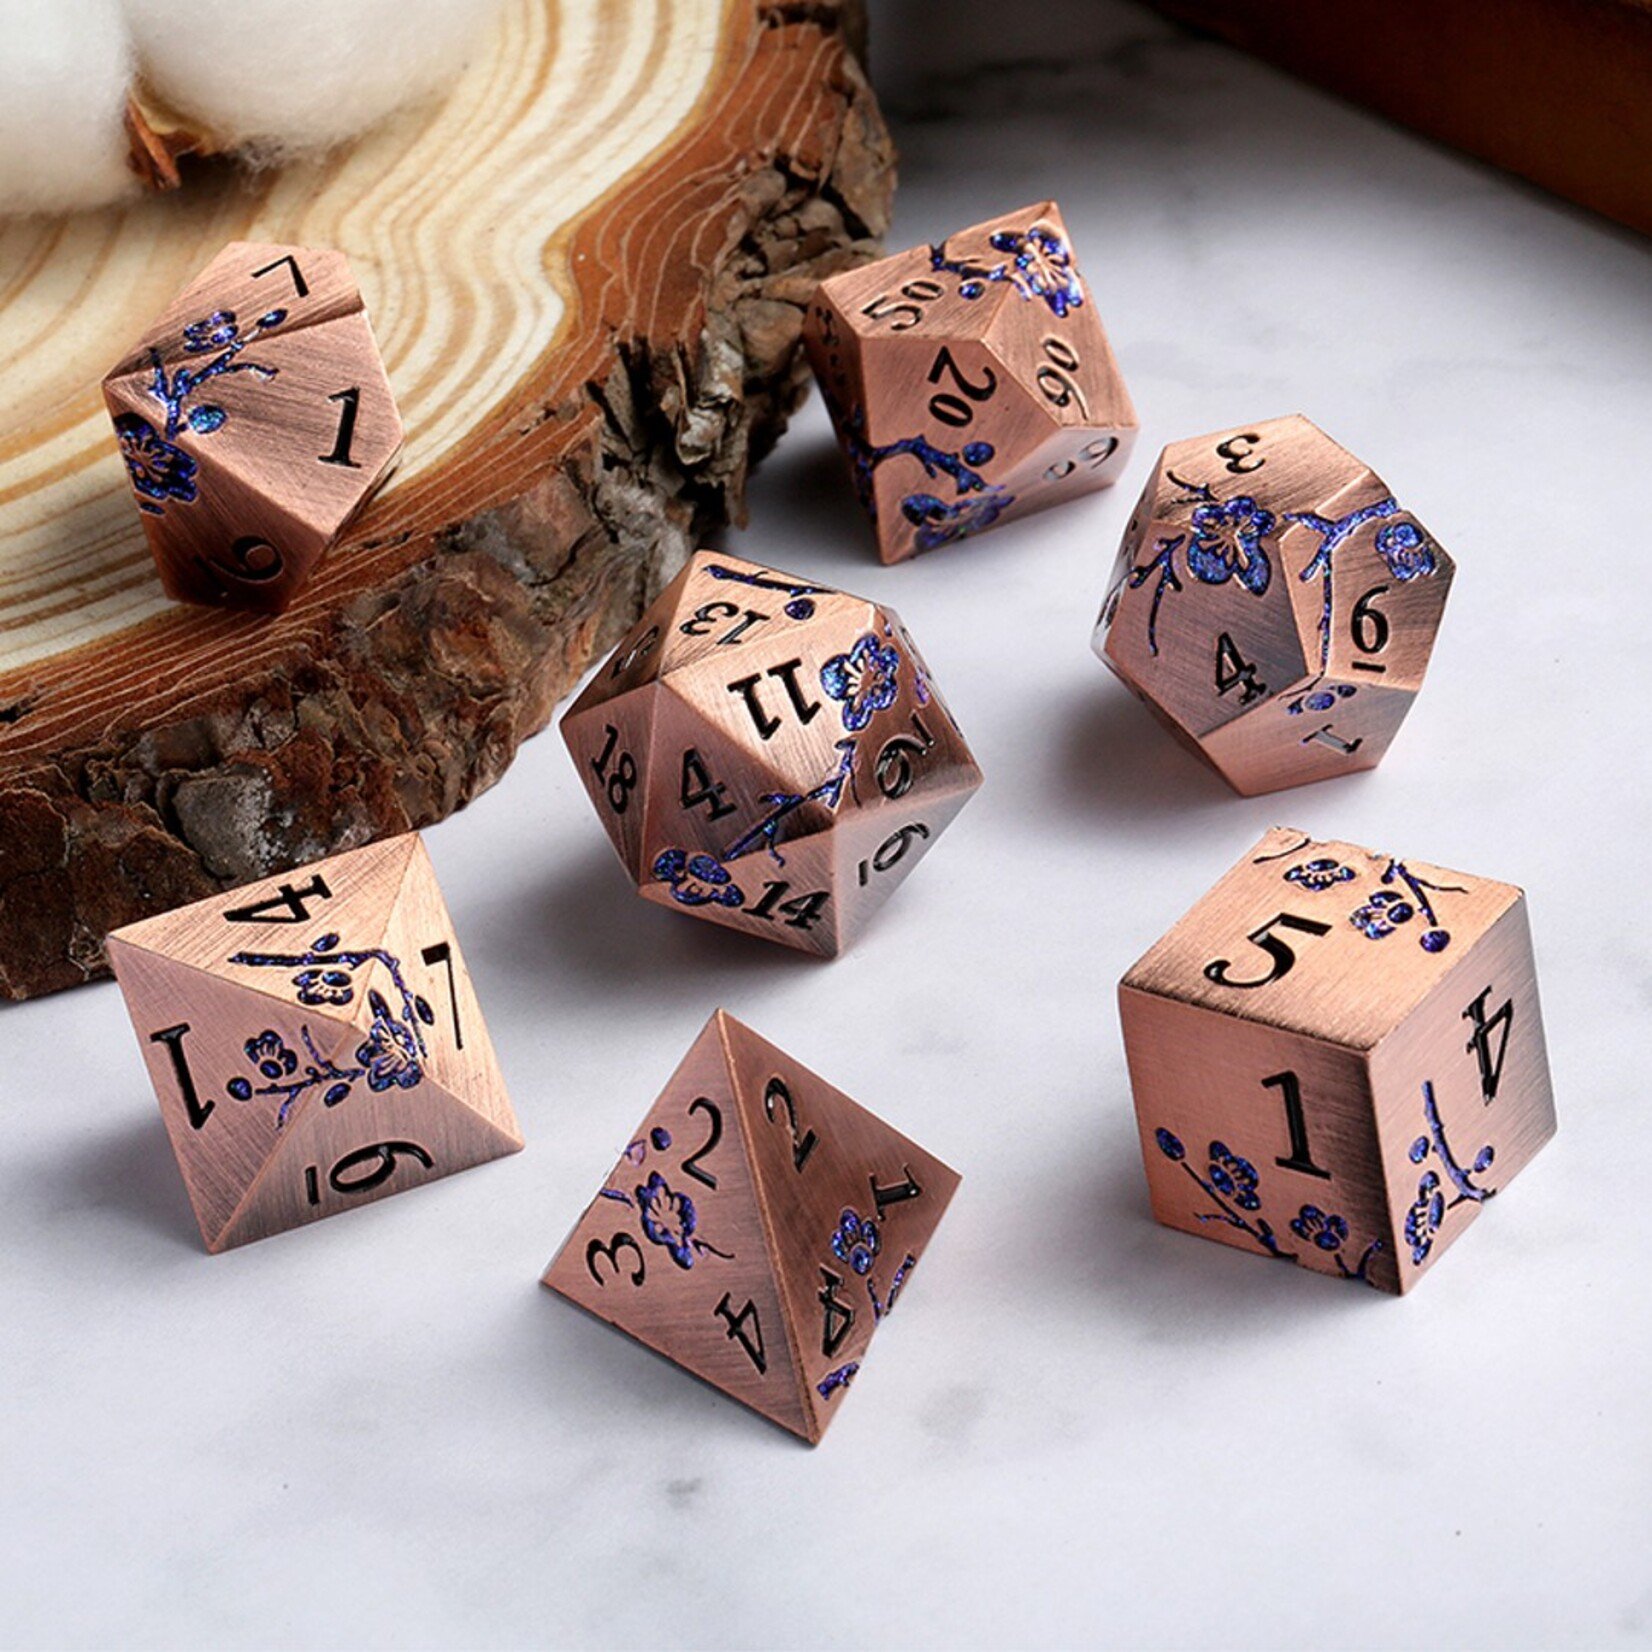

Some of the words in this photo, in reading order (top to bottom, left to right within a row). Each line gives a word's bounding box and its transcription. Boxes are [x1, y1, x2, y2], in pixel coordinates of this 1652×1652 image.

[251, 255, 309, 298] 7
[862, 280, 944, 330] 50
[928, 346, 997, 427] 20
[1037, 338, 1090, 422] 90
[318, 387, 361, 469] 1
[1216, 433, 1266, 474] 3
[680, 601, 771, 646] 13
[1350, 585, 1390, 673] 6
[727, 659, 822, 740] 11
[1216, 632, 1267, 704] 4
[589, 724, 637, 814] 18
[680, 747, 737, 822] 4
[223, 874, 333, 923] 4
[741, 881, 831, 931] 14
[1203, 912, 1333, 988] 5
[421, 942, 464, 1051] 7
[150, 1023, 215, 1130] 1
[1462, 985, 1514, 1106] 4
[681, 1097, 723, 1191] 2
[765, 1077, 820, 1174] 2
[1261, 1070, 1331, 1180] 1
[305, 1141, 434, 1206] 6
[868, 1163, 921, 1222] 1
[586, 1231, 645, 1287] 3
[714, 1292, 767, 1375] 4
[818, 1264, 854, 1358] 4
